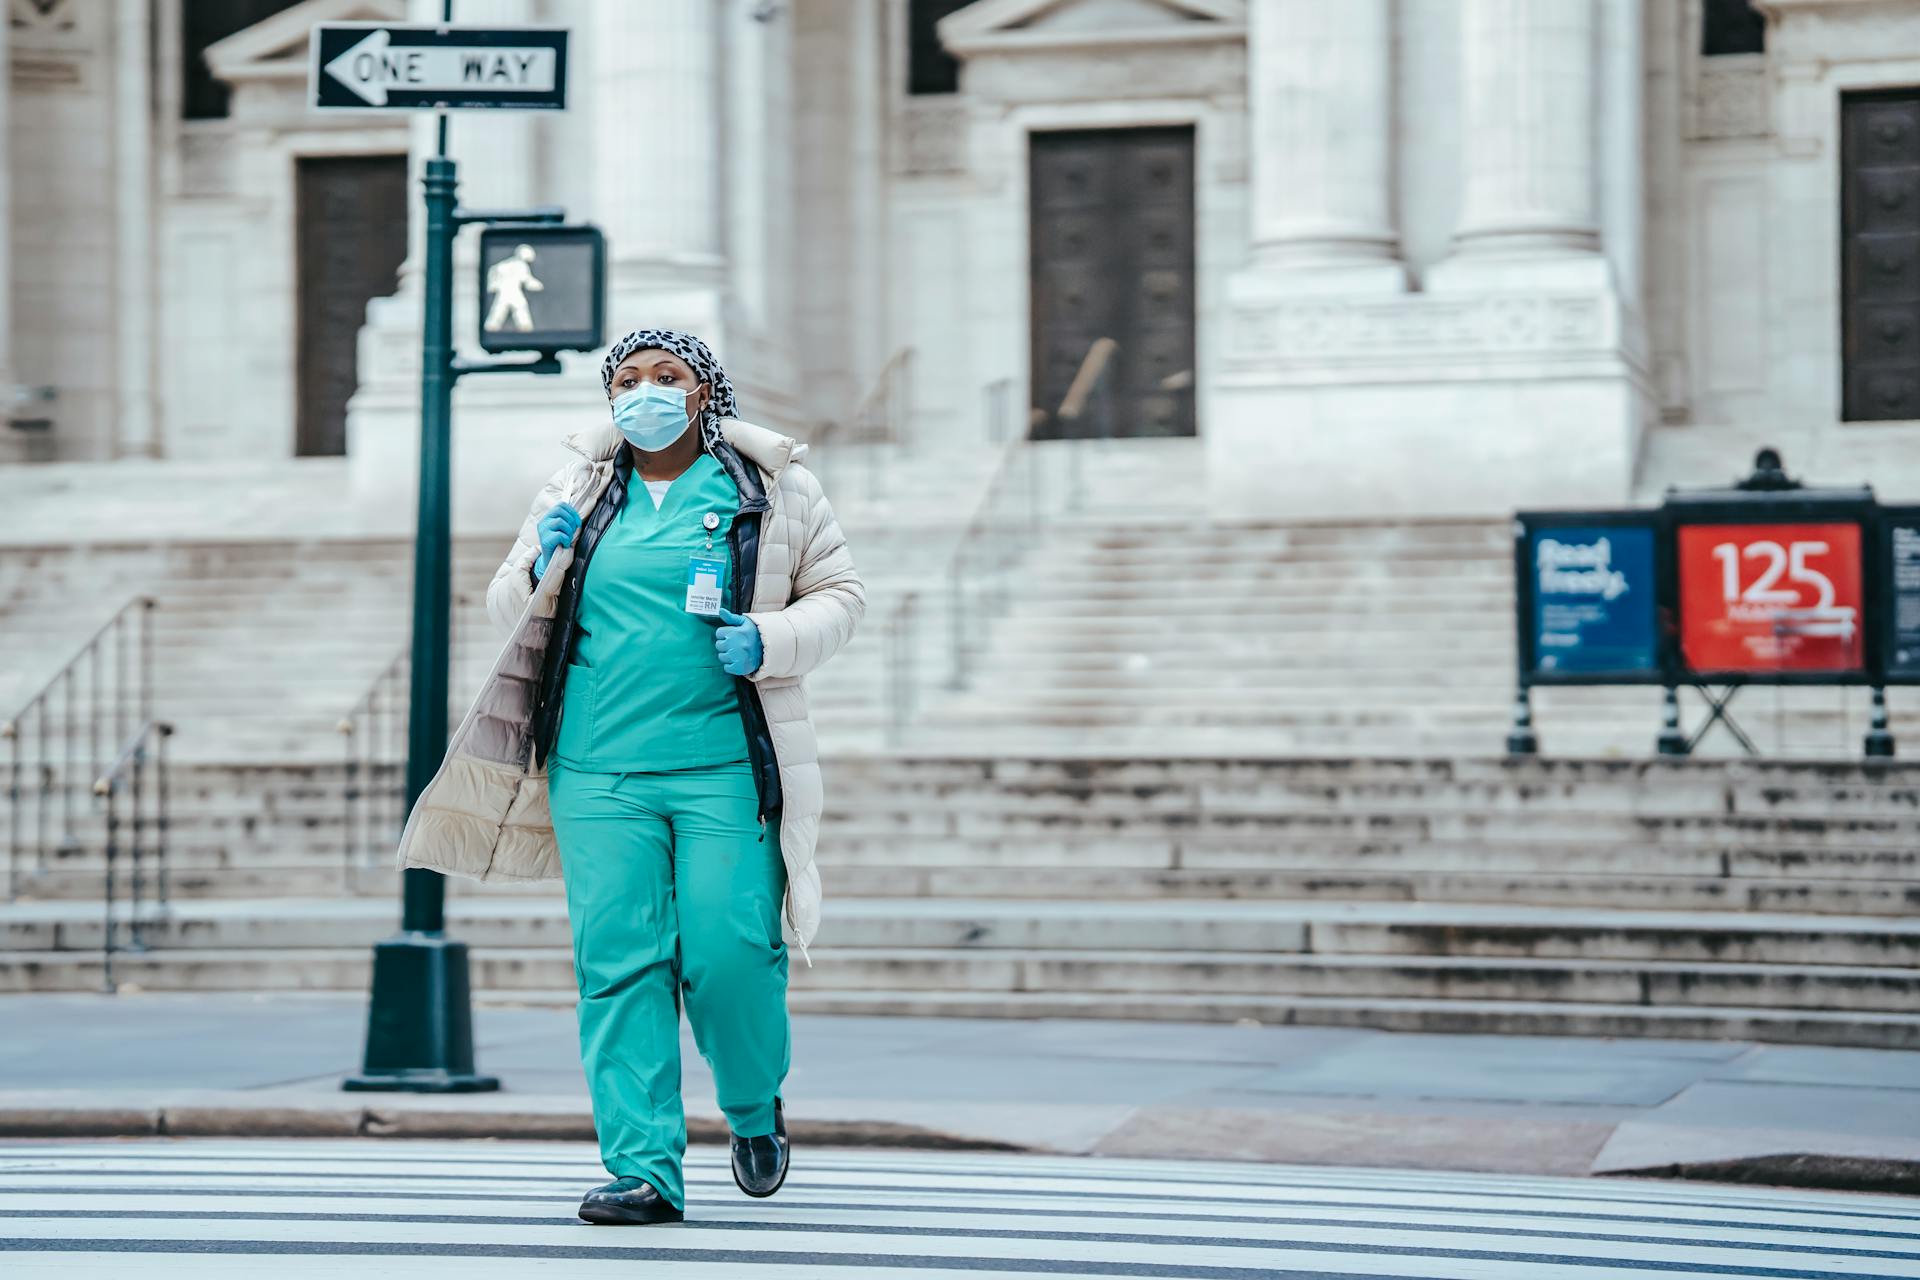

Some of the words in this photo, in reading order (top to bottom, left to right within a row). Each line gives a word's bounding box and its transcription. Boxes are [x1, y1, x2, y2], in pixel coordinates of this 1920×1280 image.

[353, 53, 423, 83] ONE
[460, 53, 535, 84] WAY
[1712, 540, 1836, 610] 125
[704, 601, 717, 610] RN
